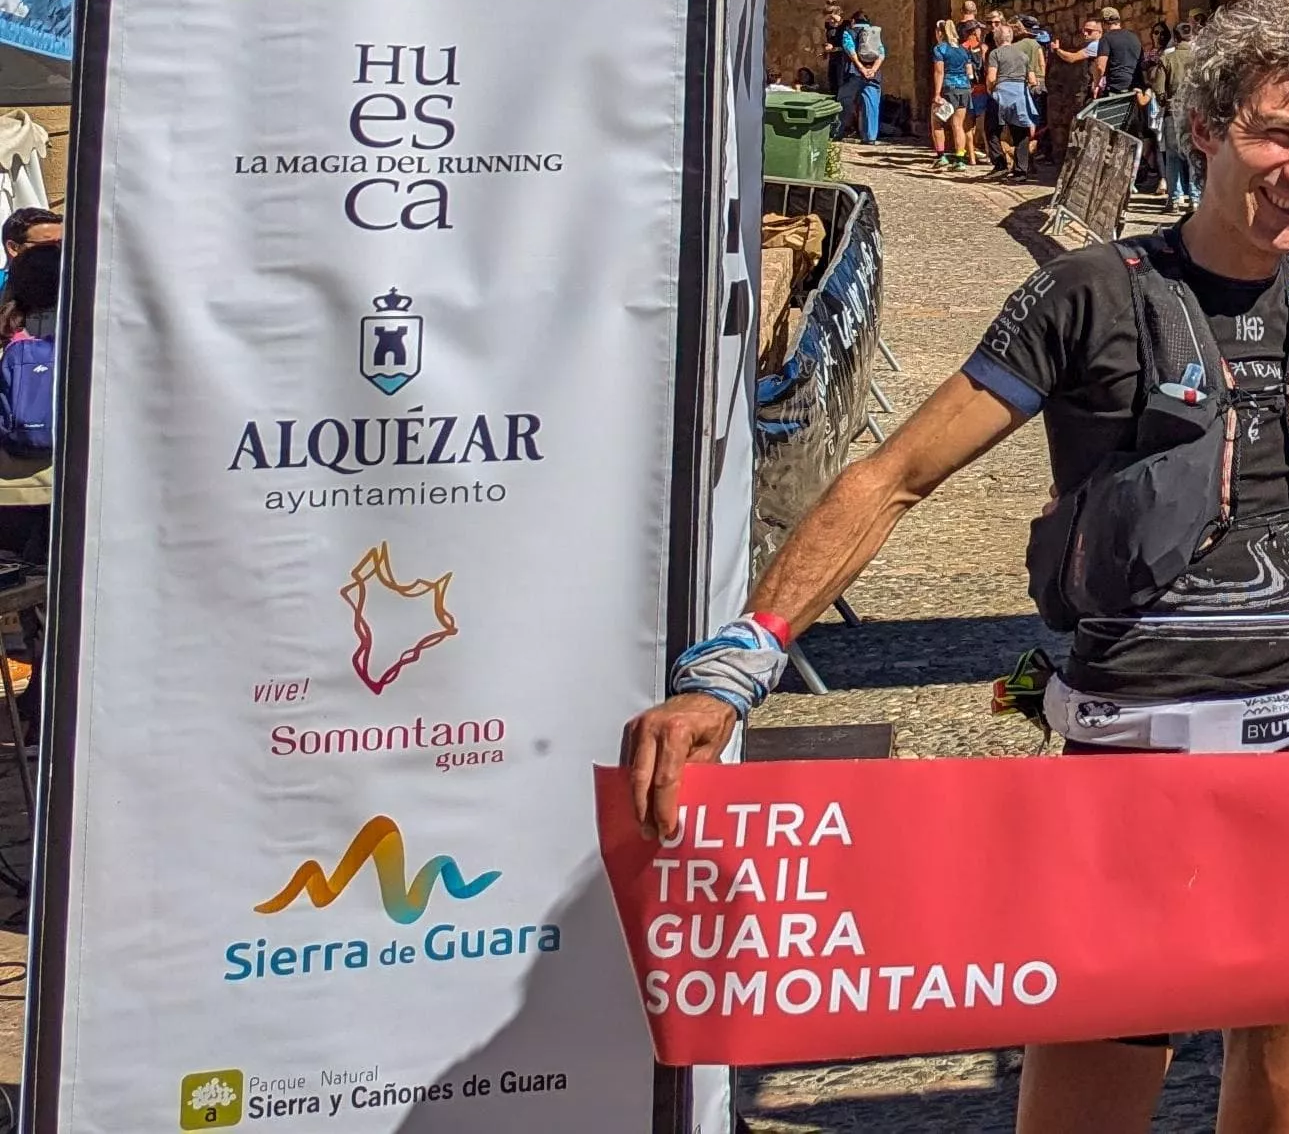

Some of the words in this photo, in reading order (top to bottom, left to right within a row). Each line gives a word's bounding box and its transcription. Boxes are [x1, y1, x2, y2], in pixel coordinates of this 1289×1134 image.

[349, 94, 456, 150] es
[344, 178, 453, 230] ca
[227, 406, 545, 474] ALQUÉZAR
[265, 481, 506, 513] ayuntamiento
[253, 678, 310, 703] vive!
[271, 718, 505, 756] Somontano
[1247, 723, 1269, 738] BY
[436, 748, 504, 773] guara
[652, 856, 828, 903] TRAIL
[224, 939, 368, 981] Sierra
[379, 940, 415, 966] de
[424, 923, 560, 962] Guara
[647, 911, 865, 959] GUARA
[646, 961, 1058, 1017] SOMONTANO
[248, 1093, 320, 1120] Sierra
[329, 1094, 343, 1115] y
[350, 1080, 453, 1110] Cañones
[462, 1073, 491, 1097] de
[500, 1070, 567, 1095] Guara
[249, 1075, 305, 1094] Parque
[320, 1066, 378, 1087] Natural
